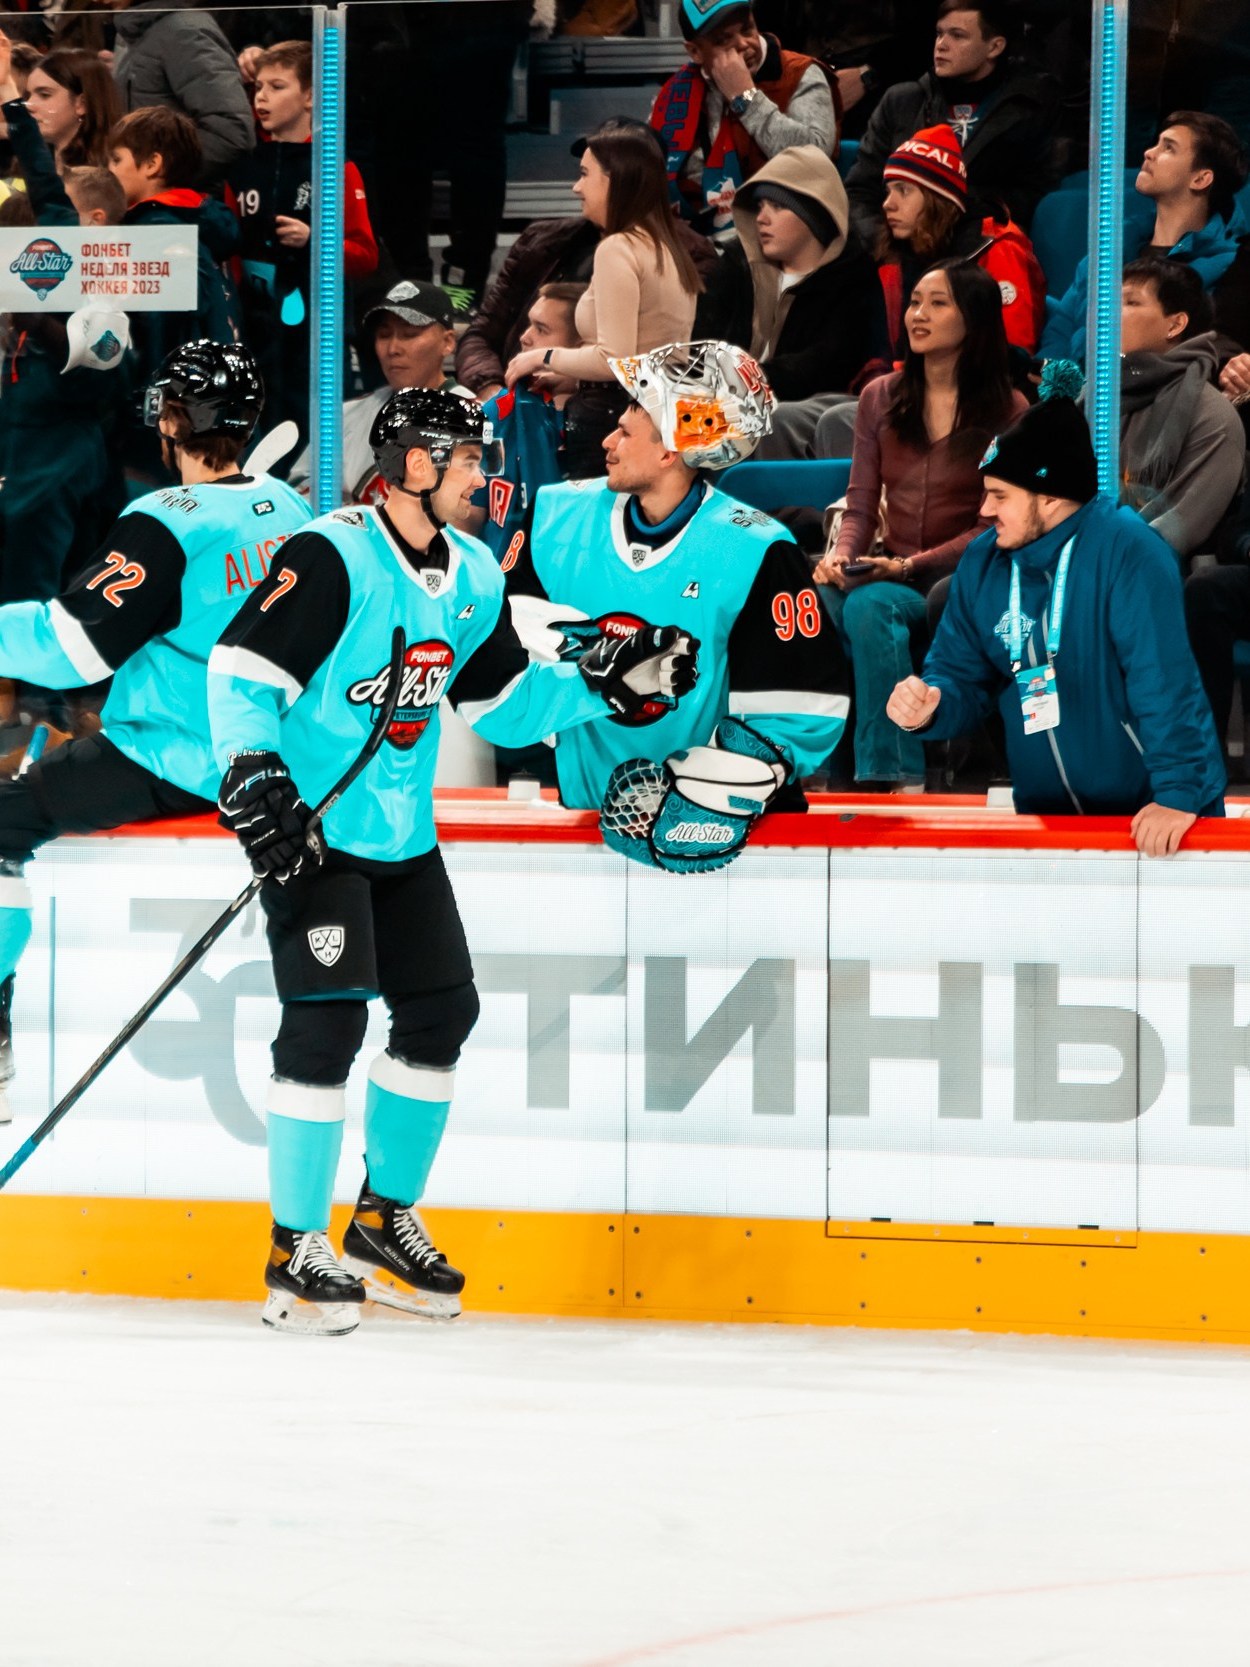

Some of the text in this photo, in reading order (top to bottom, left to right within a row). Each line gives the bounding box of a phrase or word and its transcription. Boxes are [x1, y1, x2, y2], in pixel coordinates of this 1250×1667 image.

[237, 189, 260, 217] 19
[81, 243, 131, 257] ФОНБЕТ
[11, 252, 72, 272] All-Star
[81, 262, 170, 277] НЕДЕЛЯ ЗВЕЗД
[81, 280, 160, 295] ХОККЕЯ 2023
[86, 551, 146, 608] 72
[260, 568, 297, 613] 7
[771, 588, 821, 642] 98
[410, 651, 449, 663] FONBET
[666, 822, 734, 843] All-Star
